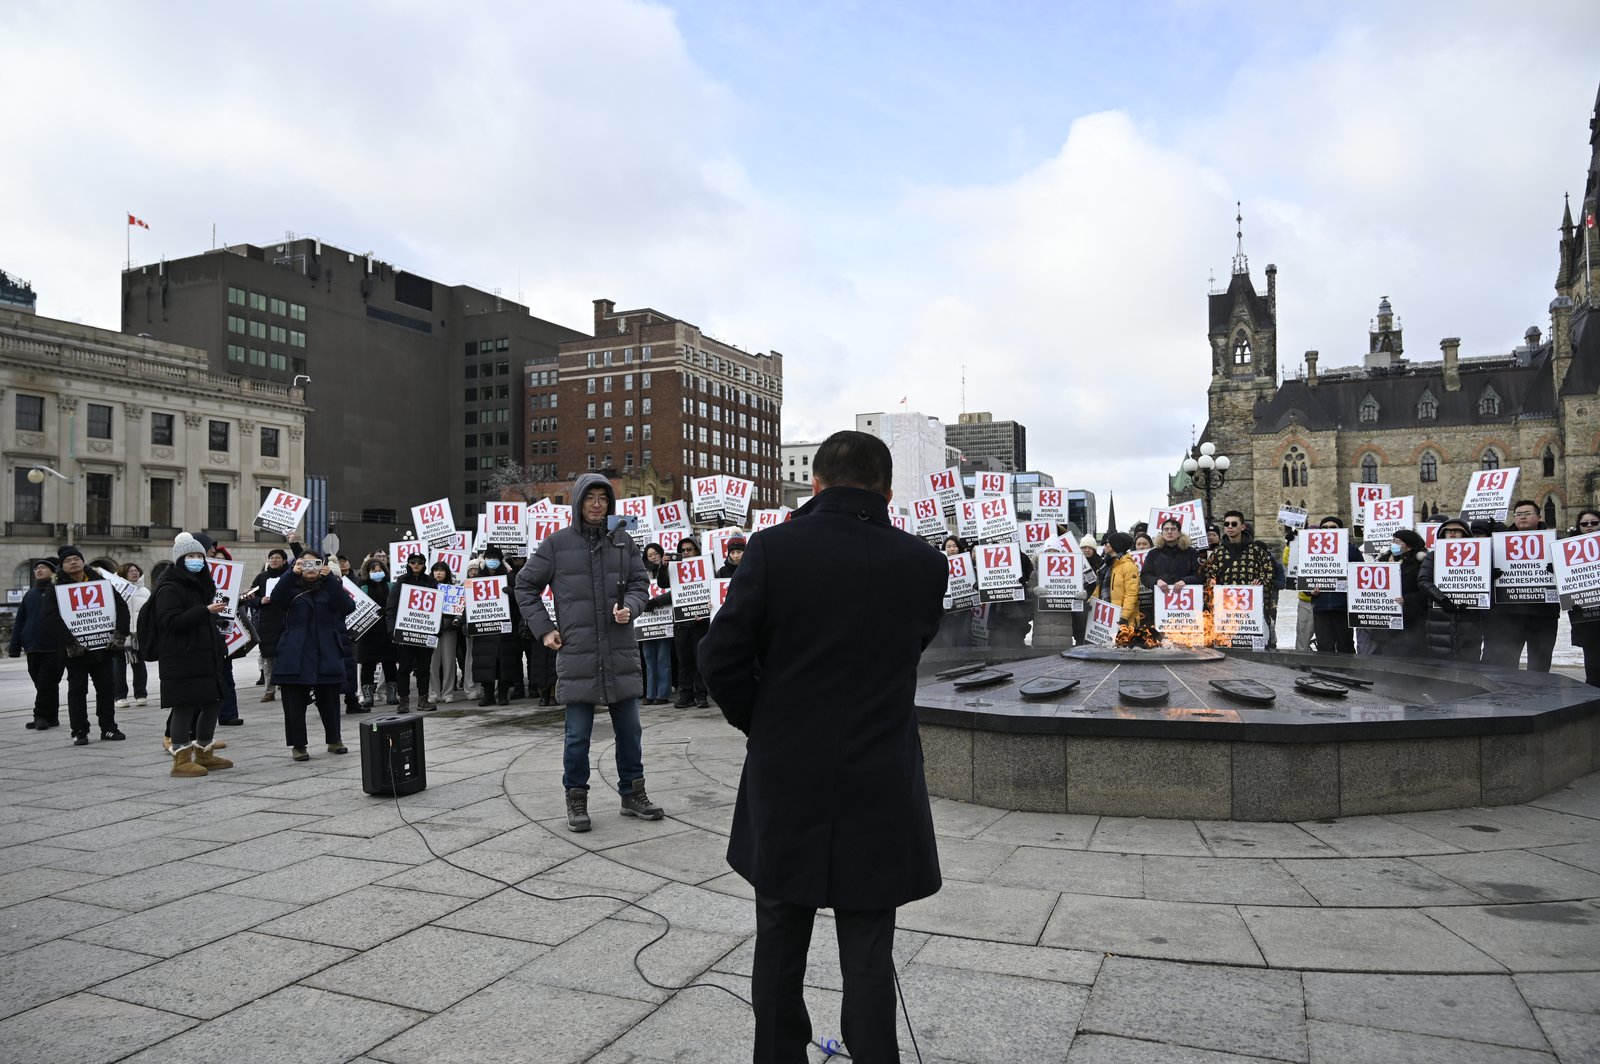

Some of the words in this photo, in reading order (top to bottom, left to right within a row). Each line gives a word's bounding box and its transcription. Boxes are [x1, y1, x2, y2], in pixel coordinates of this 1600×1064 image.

[700, 480, 715, 496] 25
[728, 480, 743, 497] 31
[934, 472, 950, 491] 27
[985, 476, 1000, 491] 19
[1480, 472, 1503, 490] 19
[277, 494, 298, 510] 13
[1042, 491, 1059, 506] 33
[267, 510, 285, 518] WAITING
[273, 508, 292, 516] MONTHS
[423, 504, 442, 523] 42
[498, 506, 515, 524] 11
[626, 500, 644, 516] 53
[661, 506, 677, 523] 19
[918, 501, 934, 518] 63
[985, 499, 1004, 519] 34
[1376, 501, 1400, 519] 35
[272, 516, 295, 526] RESPONSE
[431, 529, 452, 538] RESPONSE
[991, 526, 1015, 534] RESPONSE
[1029, 524, 1047, 541] 37
[662, 533, 679, 550] 68
[1311, 533, 1335, 554] 33
[1509, 536, 1540, 560] 30
[987, 548, 1009, 567] 72
[1449, 543, 1476, 566] 32
[1568, 538, 1599, 565] 20
[681, 561, 702, 582] 31
[1050, 557, 1071, 576] 23
[1360, 567, 1386, 589] 90
[1565, 573, 1595, 583] WAITING
[476, 581, 497, 600] 31
[682, 583, 704, 591] MONTHS
[73, 585, 101, 610] 12
[411, 590, 433, 612] 36
[687, 595, 710, 603] RESPONS
[1168, 589, 1190, 609] 25
[1227, 589, 1250, 610] 33
[70, 617, 97, 626] WAITING
[76, 610, 102, 619] MONTHS
[1096, 603, 1110, 627] 11
[83, 622, 115, 632] RESPONSE
[1090, 630, 1105, 638] WAITING
[1094, 625, 1109, 634] MONTHS
